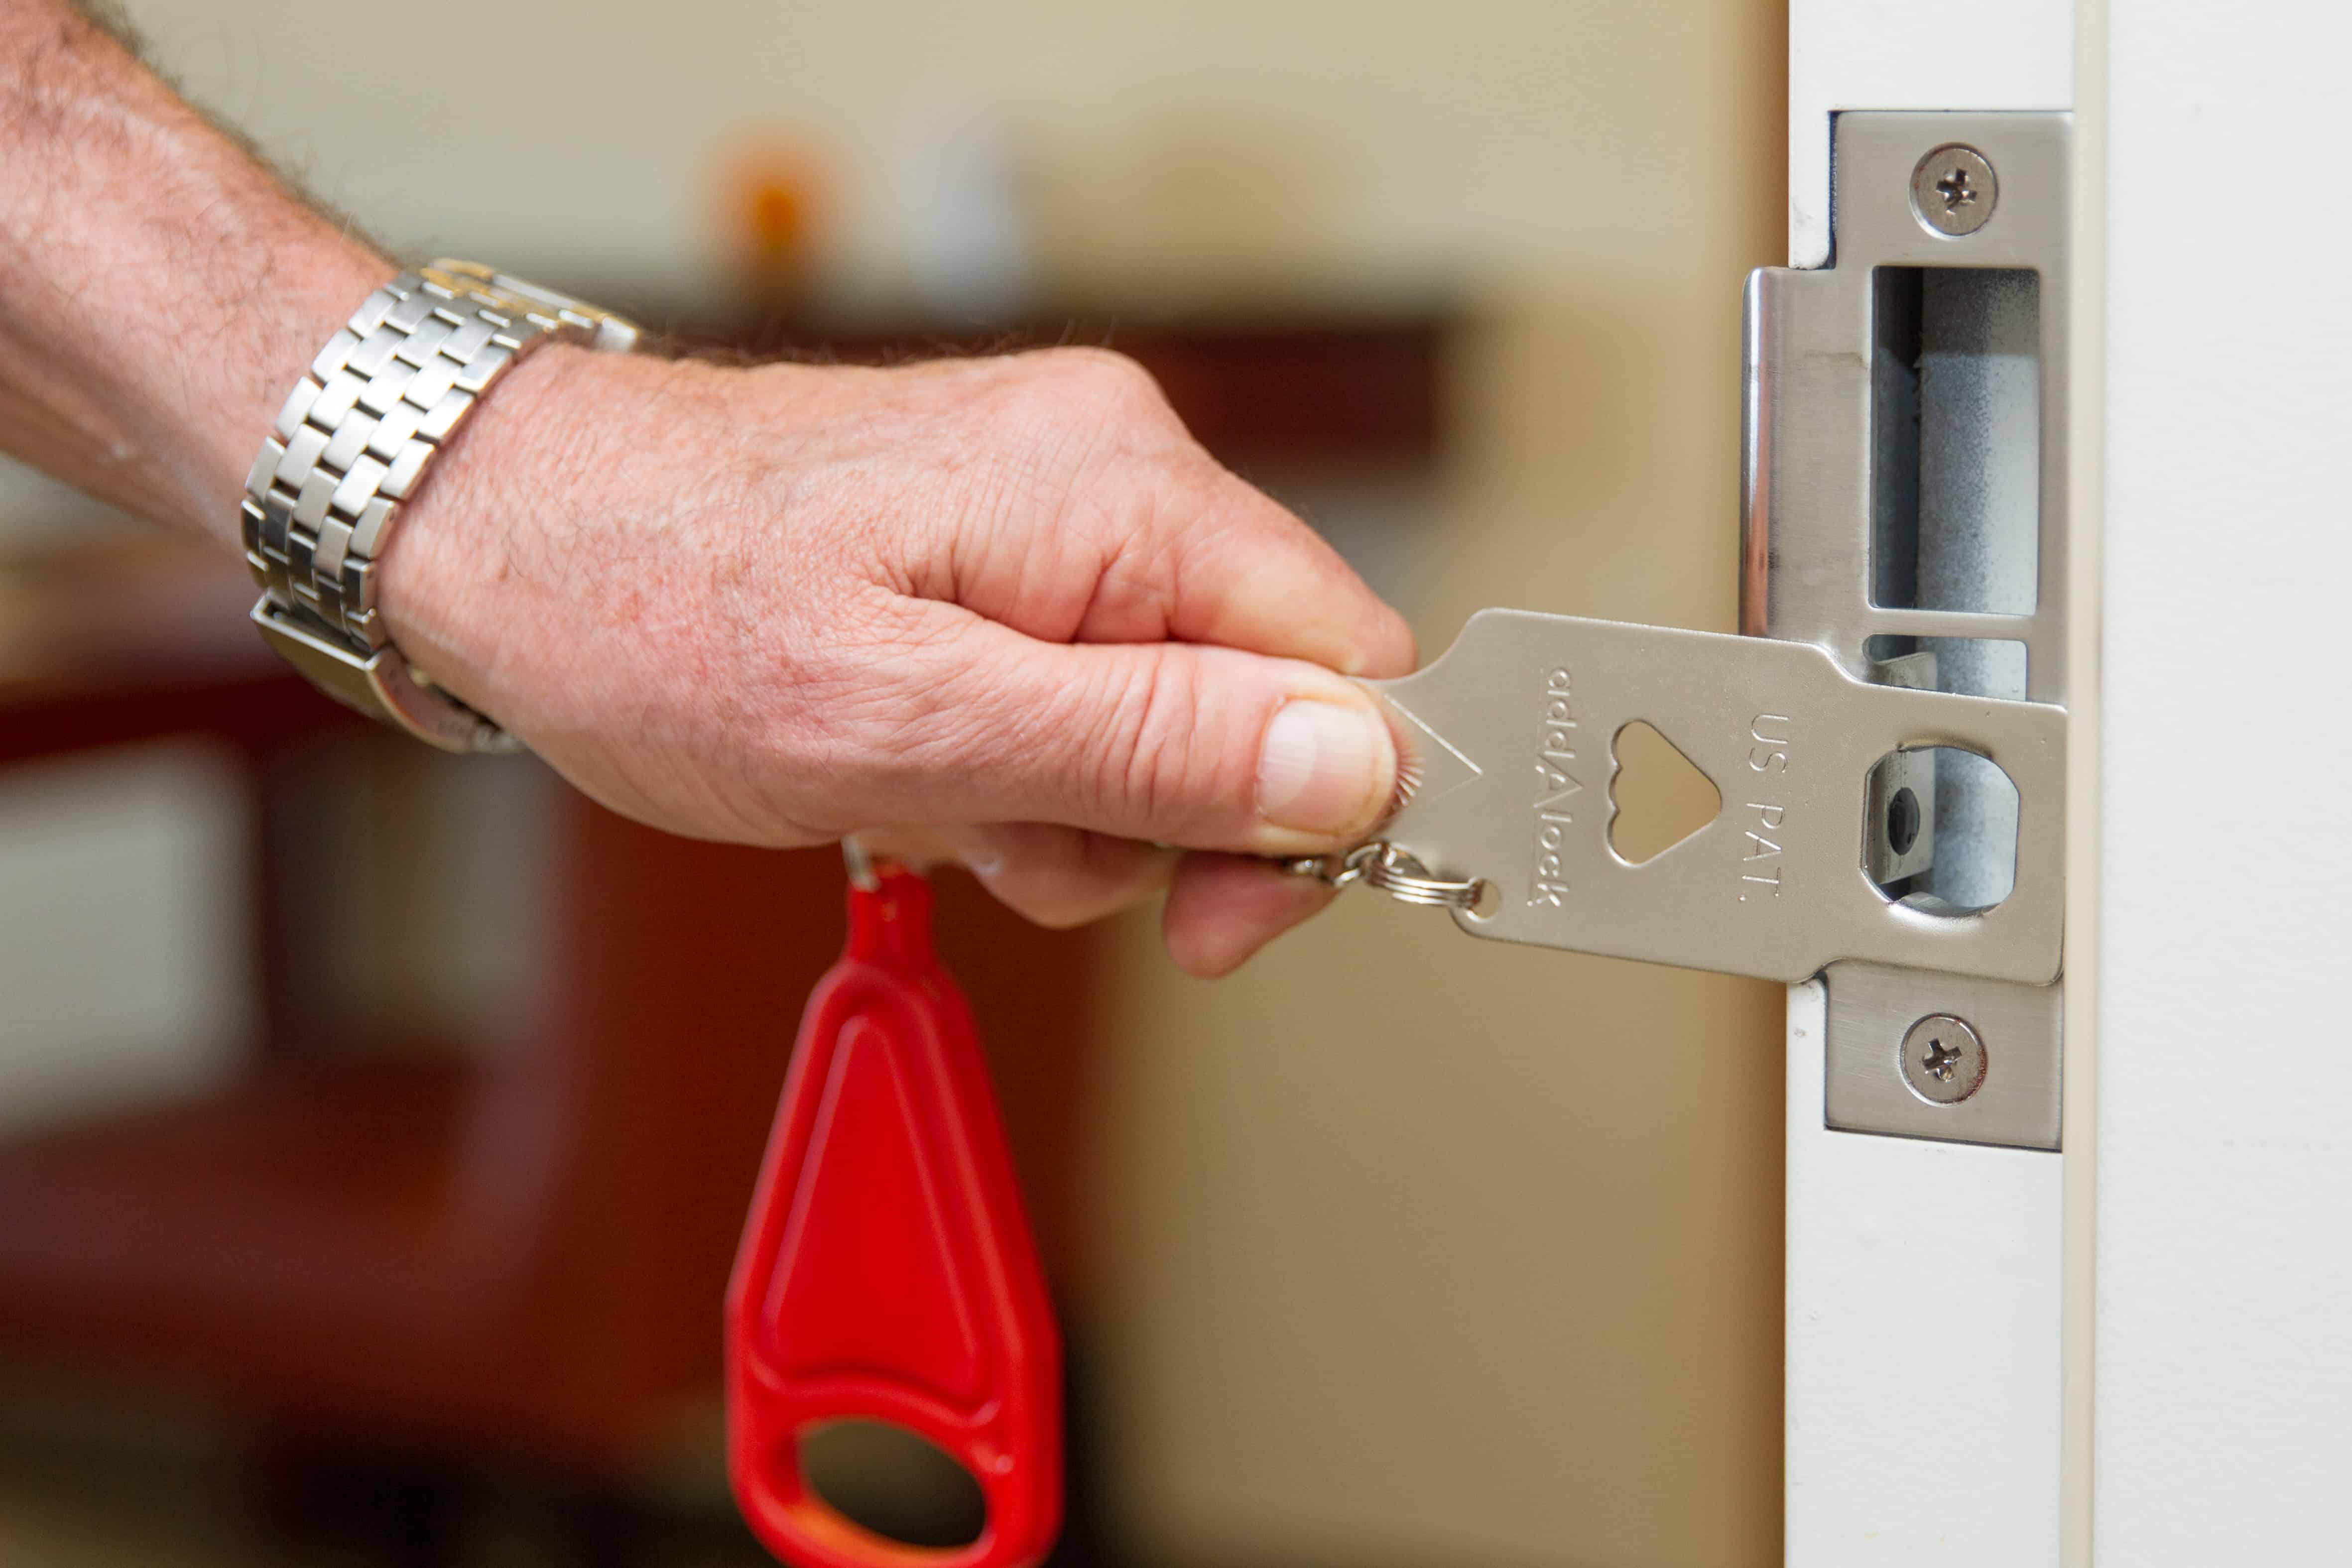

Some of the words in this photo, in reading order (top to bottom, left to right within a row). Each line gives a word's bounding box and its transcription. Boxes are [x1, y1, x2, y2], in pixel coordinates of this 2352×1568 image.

[1533, 668, 1584, 907] addAlock
[1749, 713, 1790, 773] US
[1739, 803, 1785, 902] PAT.
